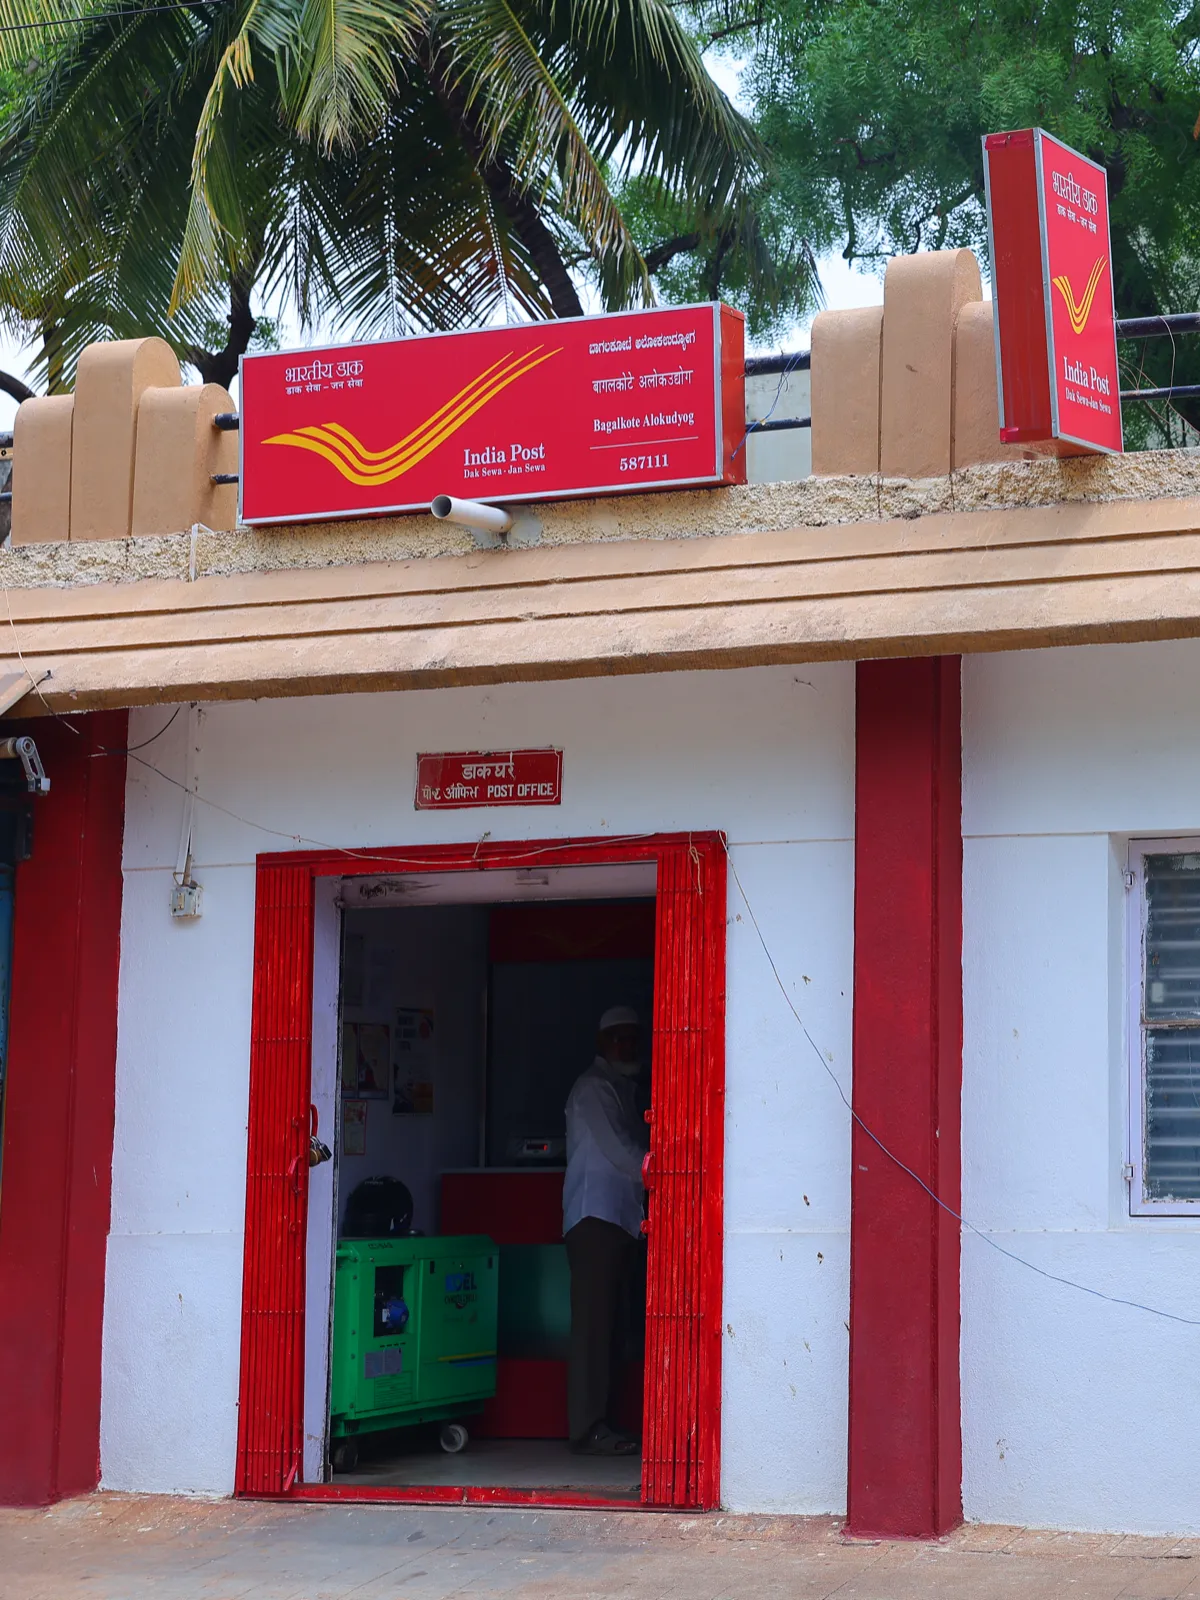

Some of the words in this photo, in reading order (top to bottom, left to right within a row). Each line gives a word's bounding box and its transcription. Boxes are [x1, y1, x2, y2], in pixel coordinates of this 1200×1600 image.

[1052, 170, 1081, 208] भारतीय
[1081, 187, 1098, 216] डाक
[285, 359, 334, 382] भारतीय
[335, 360, 364, 377] डाक
[1063, 355, 1089, 388] India
[1089, 366, 1110, 396] Post
[285, 385, 302, 395] डाक
[305, 382, 321, 393] सेवा
[330, 381, 344, 390] जन
[346, 377, 364, 389] सेवा
[592, 371, 634, 394] बागलकोटे
[593, 416, 640, 434] Bagalkote
[643, 411, 694, 427] Alokudyog
[463, 446, 506, 466] India
[510, 442, 546, 462] Post
[619, 454, 669, 471] 587111
[463, 468, 480, 479] Dak
[481, 467, 502, 477] Sewa
[508, 464, 523, 475] Jan
[524, 463, 546, 473] Sewa
[487, 784, 514, 798] POST
[517, 782, 554, 797] OFFICE
